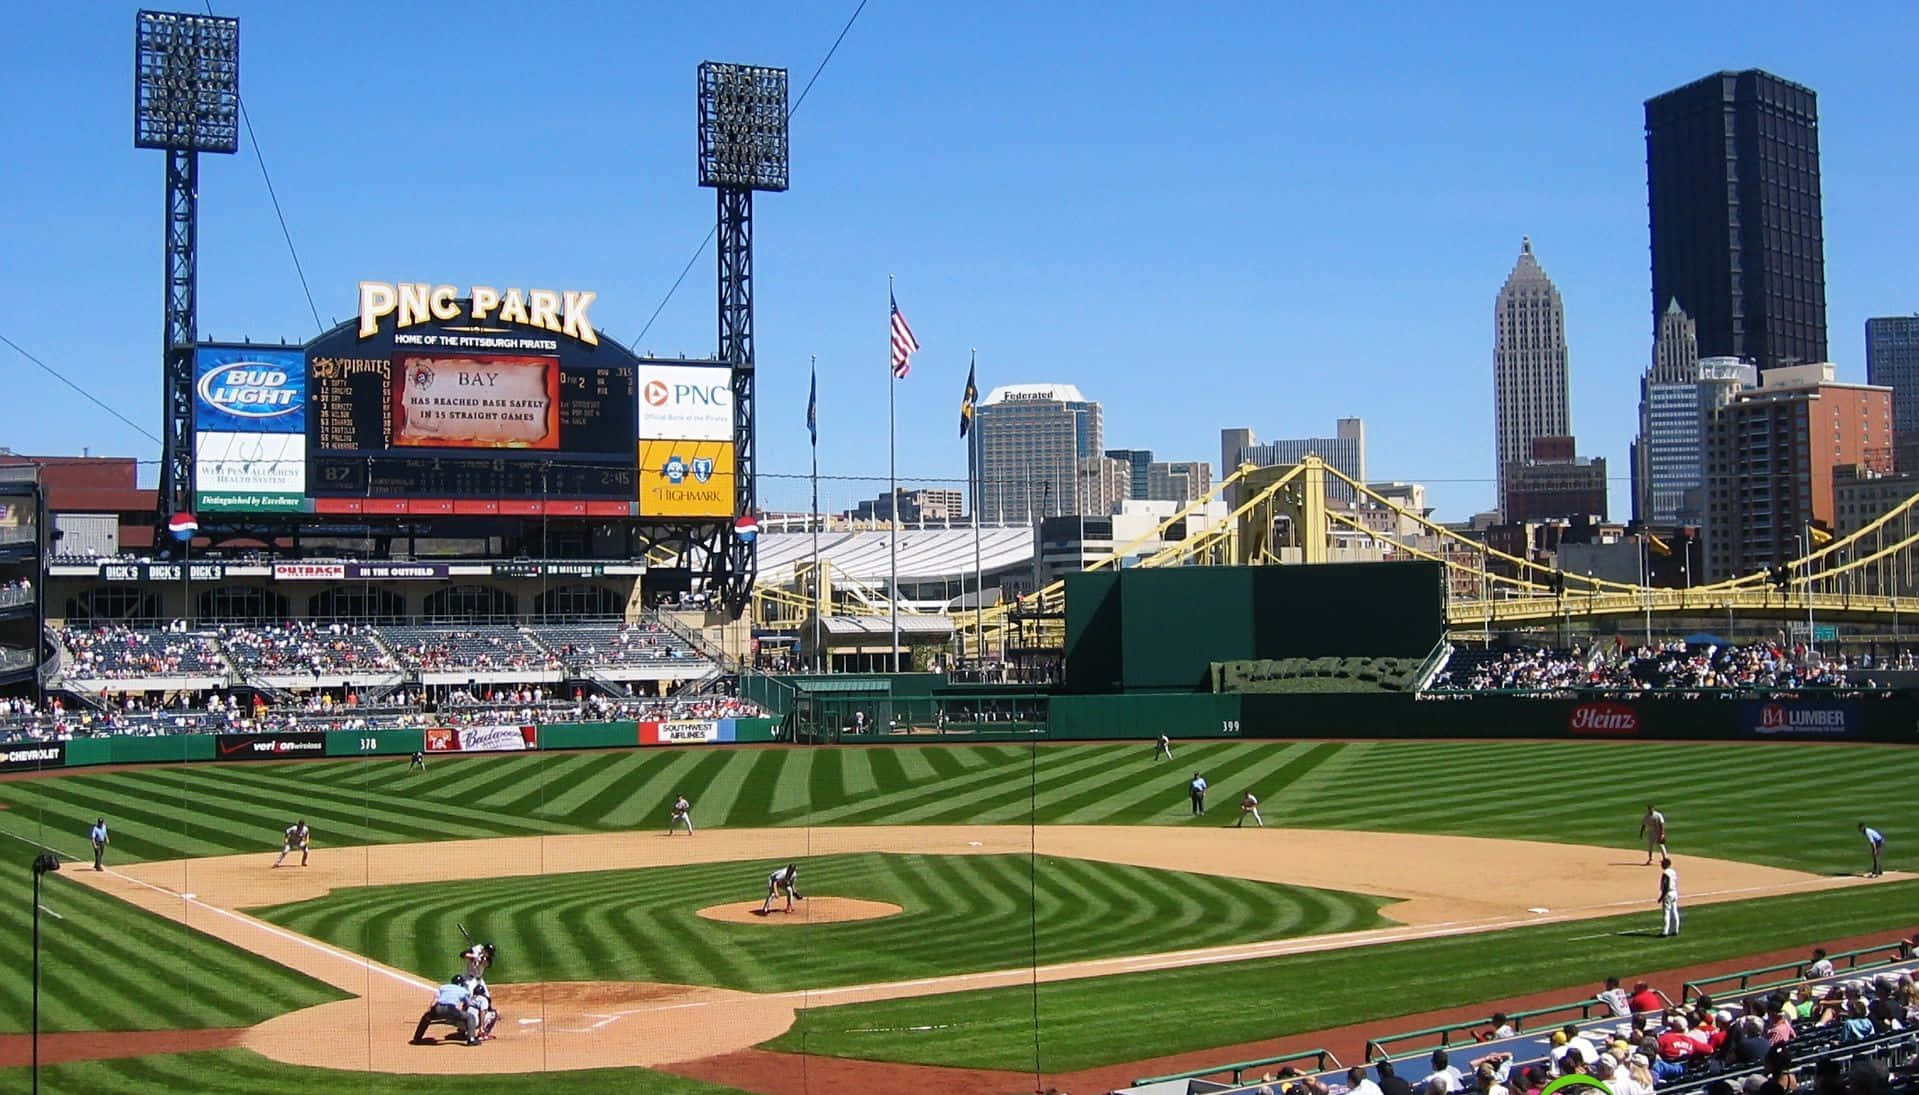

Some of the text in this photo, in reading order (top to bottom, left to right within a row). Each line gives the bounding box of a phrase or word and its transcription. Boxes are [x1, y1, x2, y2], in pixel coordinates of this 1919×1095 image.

[359, 280, 598, 346] PNC PARK
[394, 334, 557, 350] HOME OF THE PITTSBURGH PIRATES
[344, 359, 391, 379] PIRATES
[225, 370, 287, 387] BUD
[457, 372, 500, 387] BAY
[579, 377, 585, 389] 2
[214, 387, 297, 405] LIGHT
[673, 384, 727, 406] PNC
[1004, 391, 1054, 400] Federated
[410, 397, 544, 409] HAS REACHED BASE SAFELY
[420, 410, 535, 421] IN 15 STRAIGHT GAMES
[217, 475, 286, 484] HEALTH SYSTEM
[601, 471, 630, 485] 2:45
[202, 496, 299, 506] Distinguished by Excellence
[658, 489, 721, 502] HIGHMARK
[106, 566, 138, 577] DICK'S
[149, 566, 181, 577] DICK'S
[190, 566, 222, 577] DICK'S
[277, 566, 342, 575] OUTBACK
[373, 568, 389, 576] THE
[391, 568, 434, 577] OUTFIELD
[559, 566, 592, 574] MILLION
[1572, 708, 1637, 729] Heinz
[1763, 709, 1845, 725] 84 LUMBER
[663, 723, 713, 732] SOUTHWEST
[670, 731, 707, 739] AIRLINES
[360, 738, 377, 750] 378
[9, 748, 60, 762] CHEVROLET
